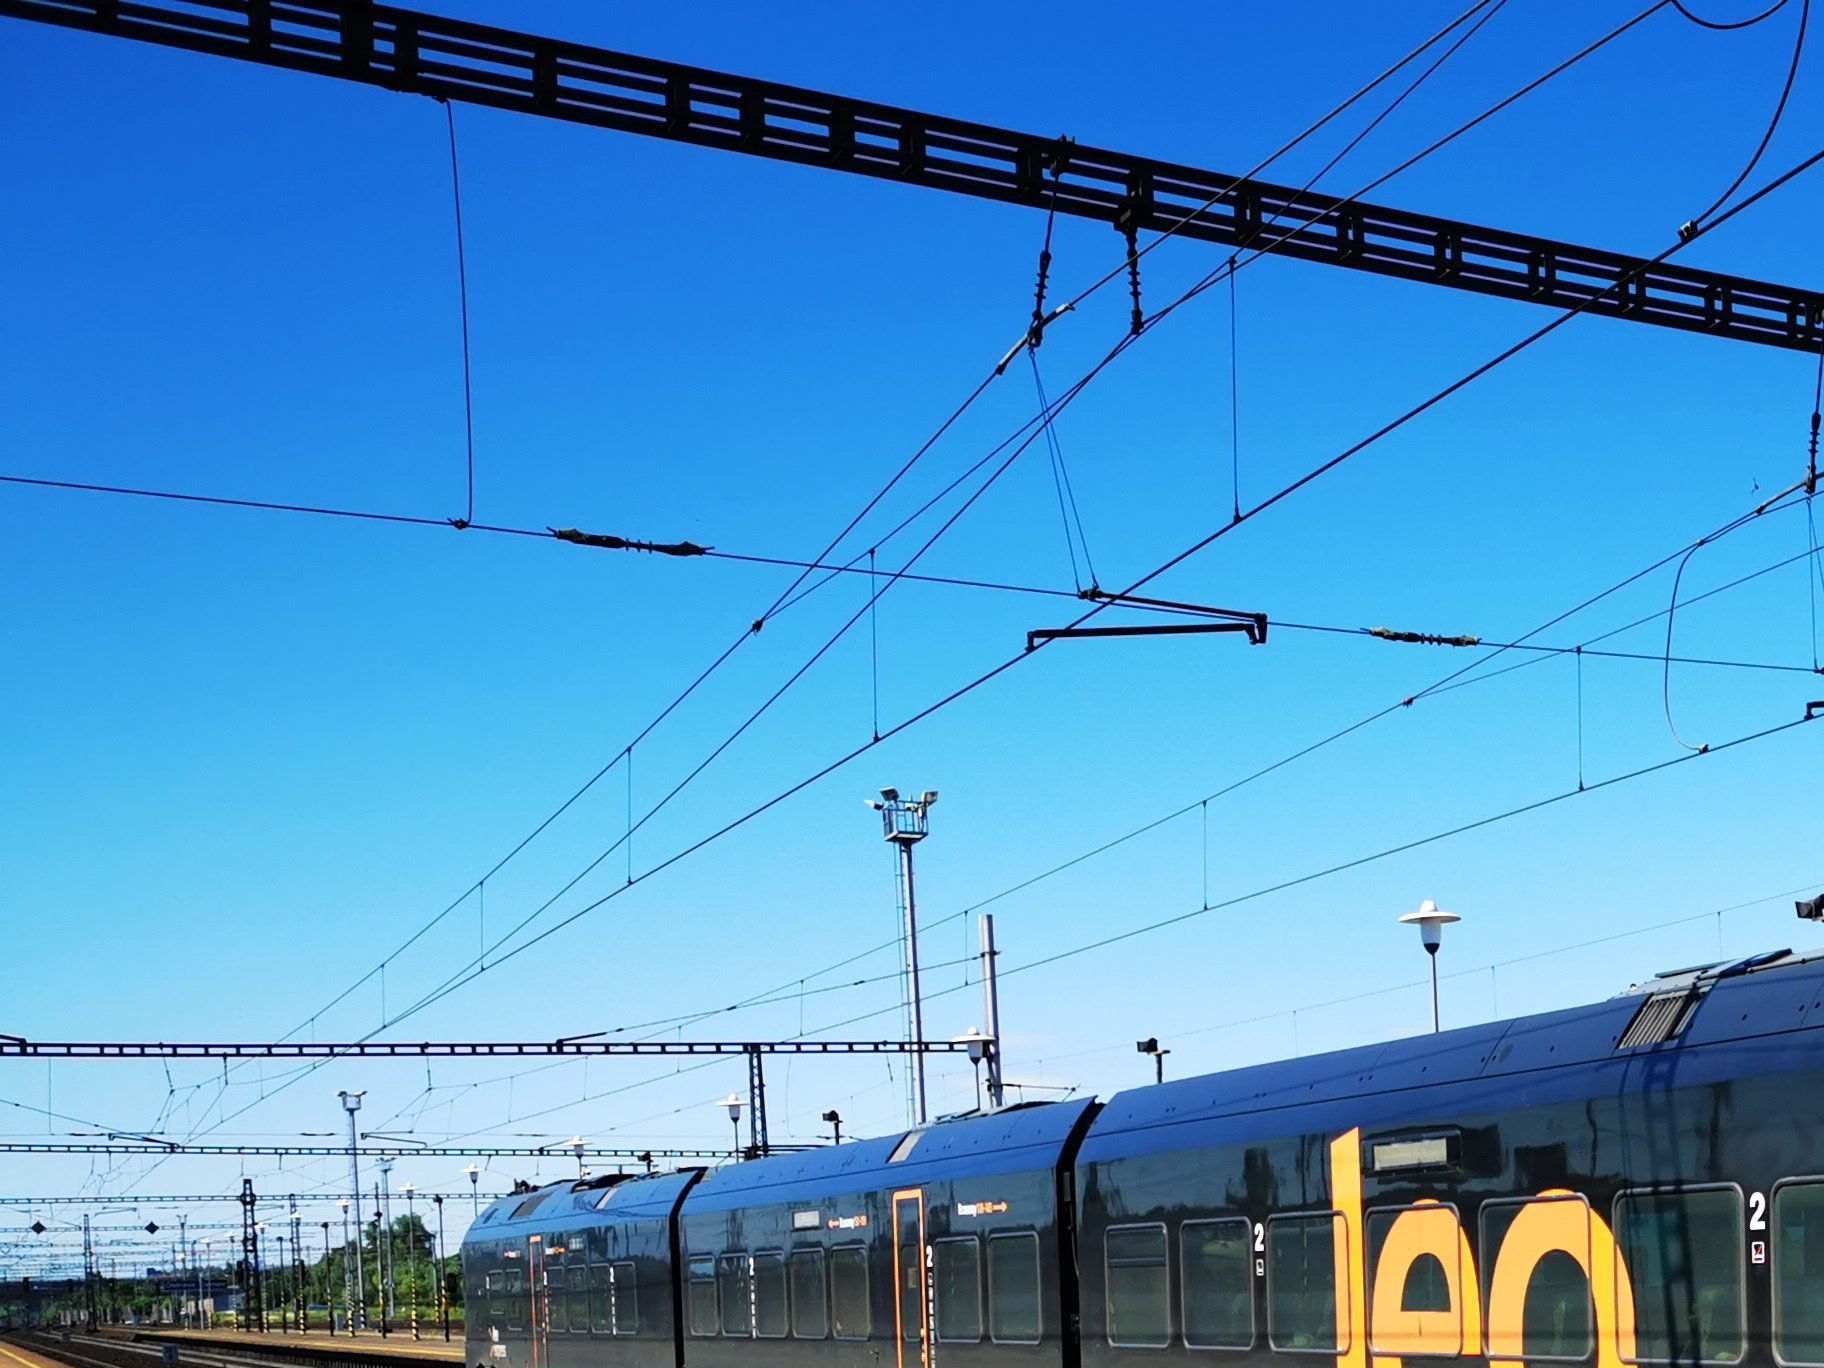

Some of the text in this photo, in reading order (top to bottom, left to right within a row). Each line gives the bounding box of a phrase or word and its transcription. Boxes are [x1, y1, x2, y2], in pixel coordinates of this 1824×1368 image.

[1749, 1191, 1766, 1231] 2
[1253, 1222, 1265, 1252] 2
[926, 1245, 933, 1267] 2
